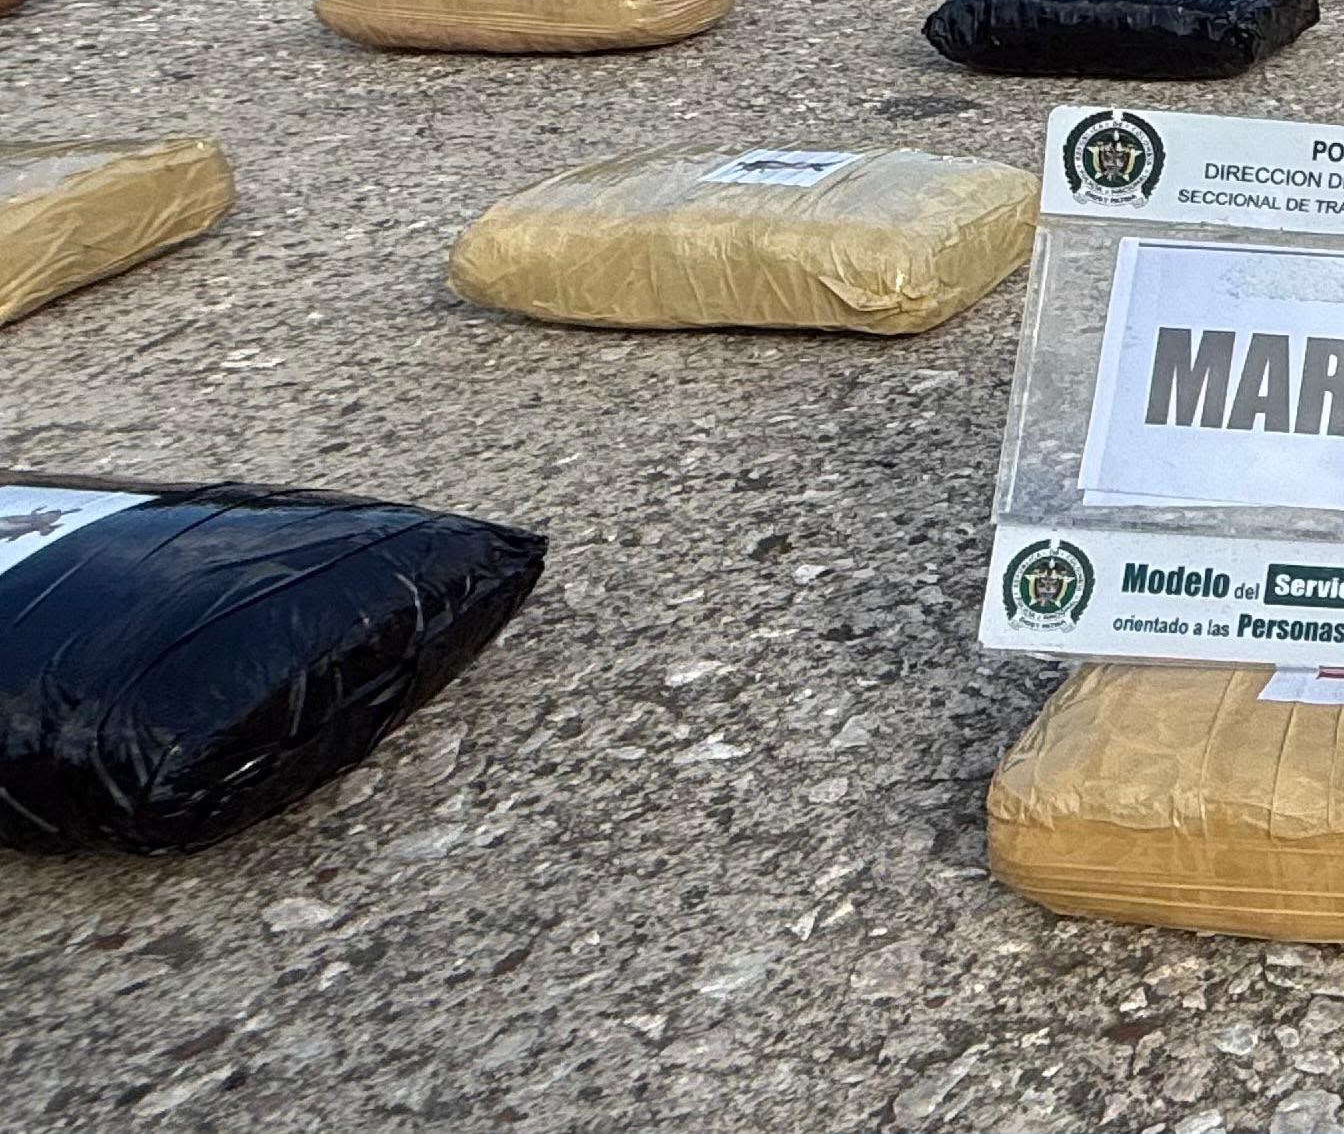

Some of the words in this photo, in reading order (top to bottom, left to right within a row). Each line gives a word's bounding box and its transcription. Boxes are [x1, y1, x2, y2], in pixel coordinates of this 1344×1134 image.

[1177, 189, 1281, 210] SECCIONAL
[1286, 196, 1310, 213] DE
[1121, 563, 1230, 599] Modelo
[1234, 583, 1260, 600] del
[1113, 615, 1189, 636] orientado
[1193, 622, 1202, 636] a
[1207, 619, 1230, 638] las
